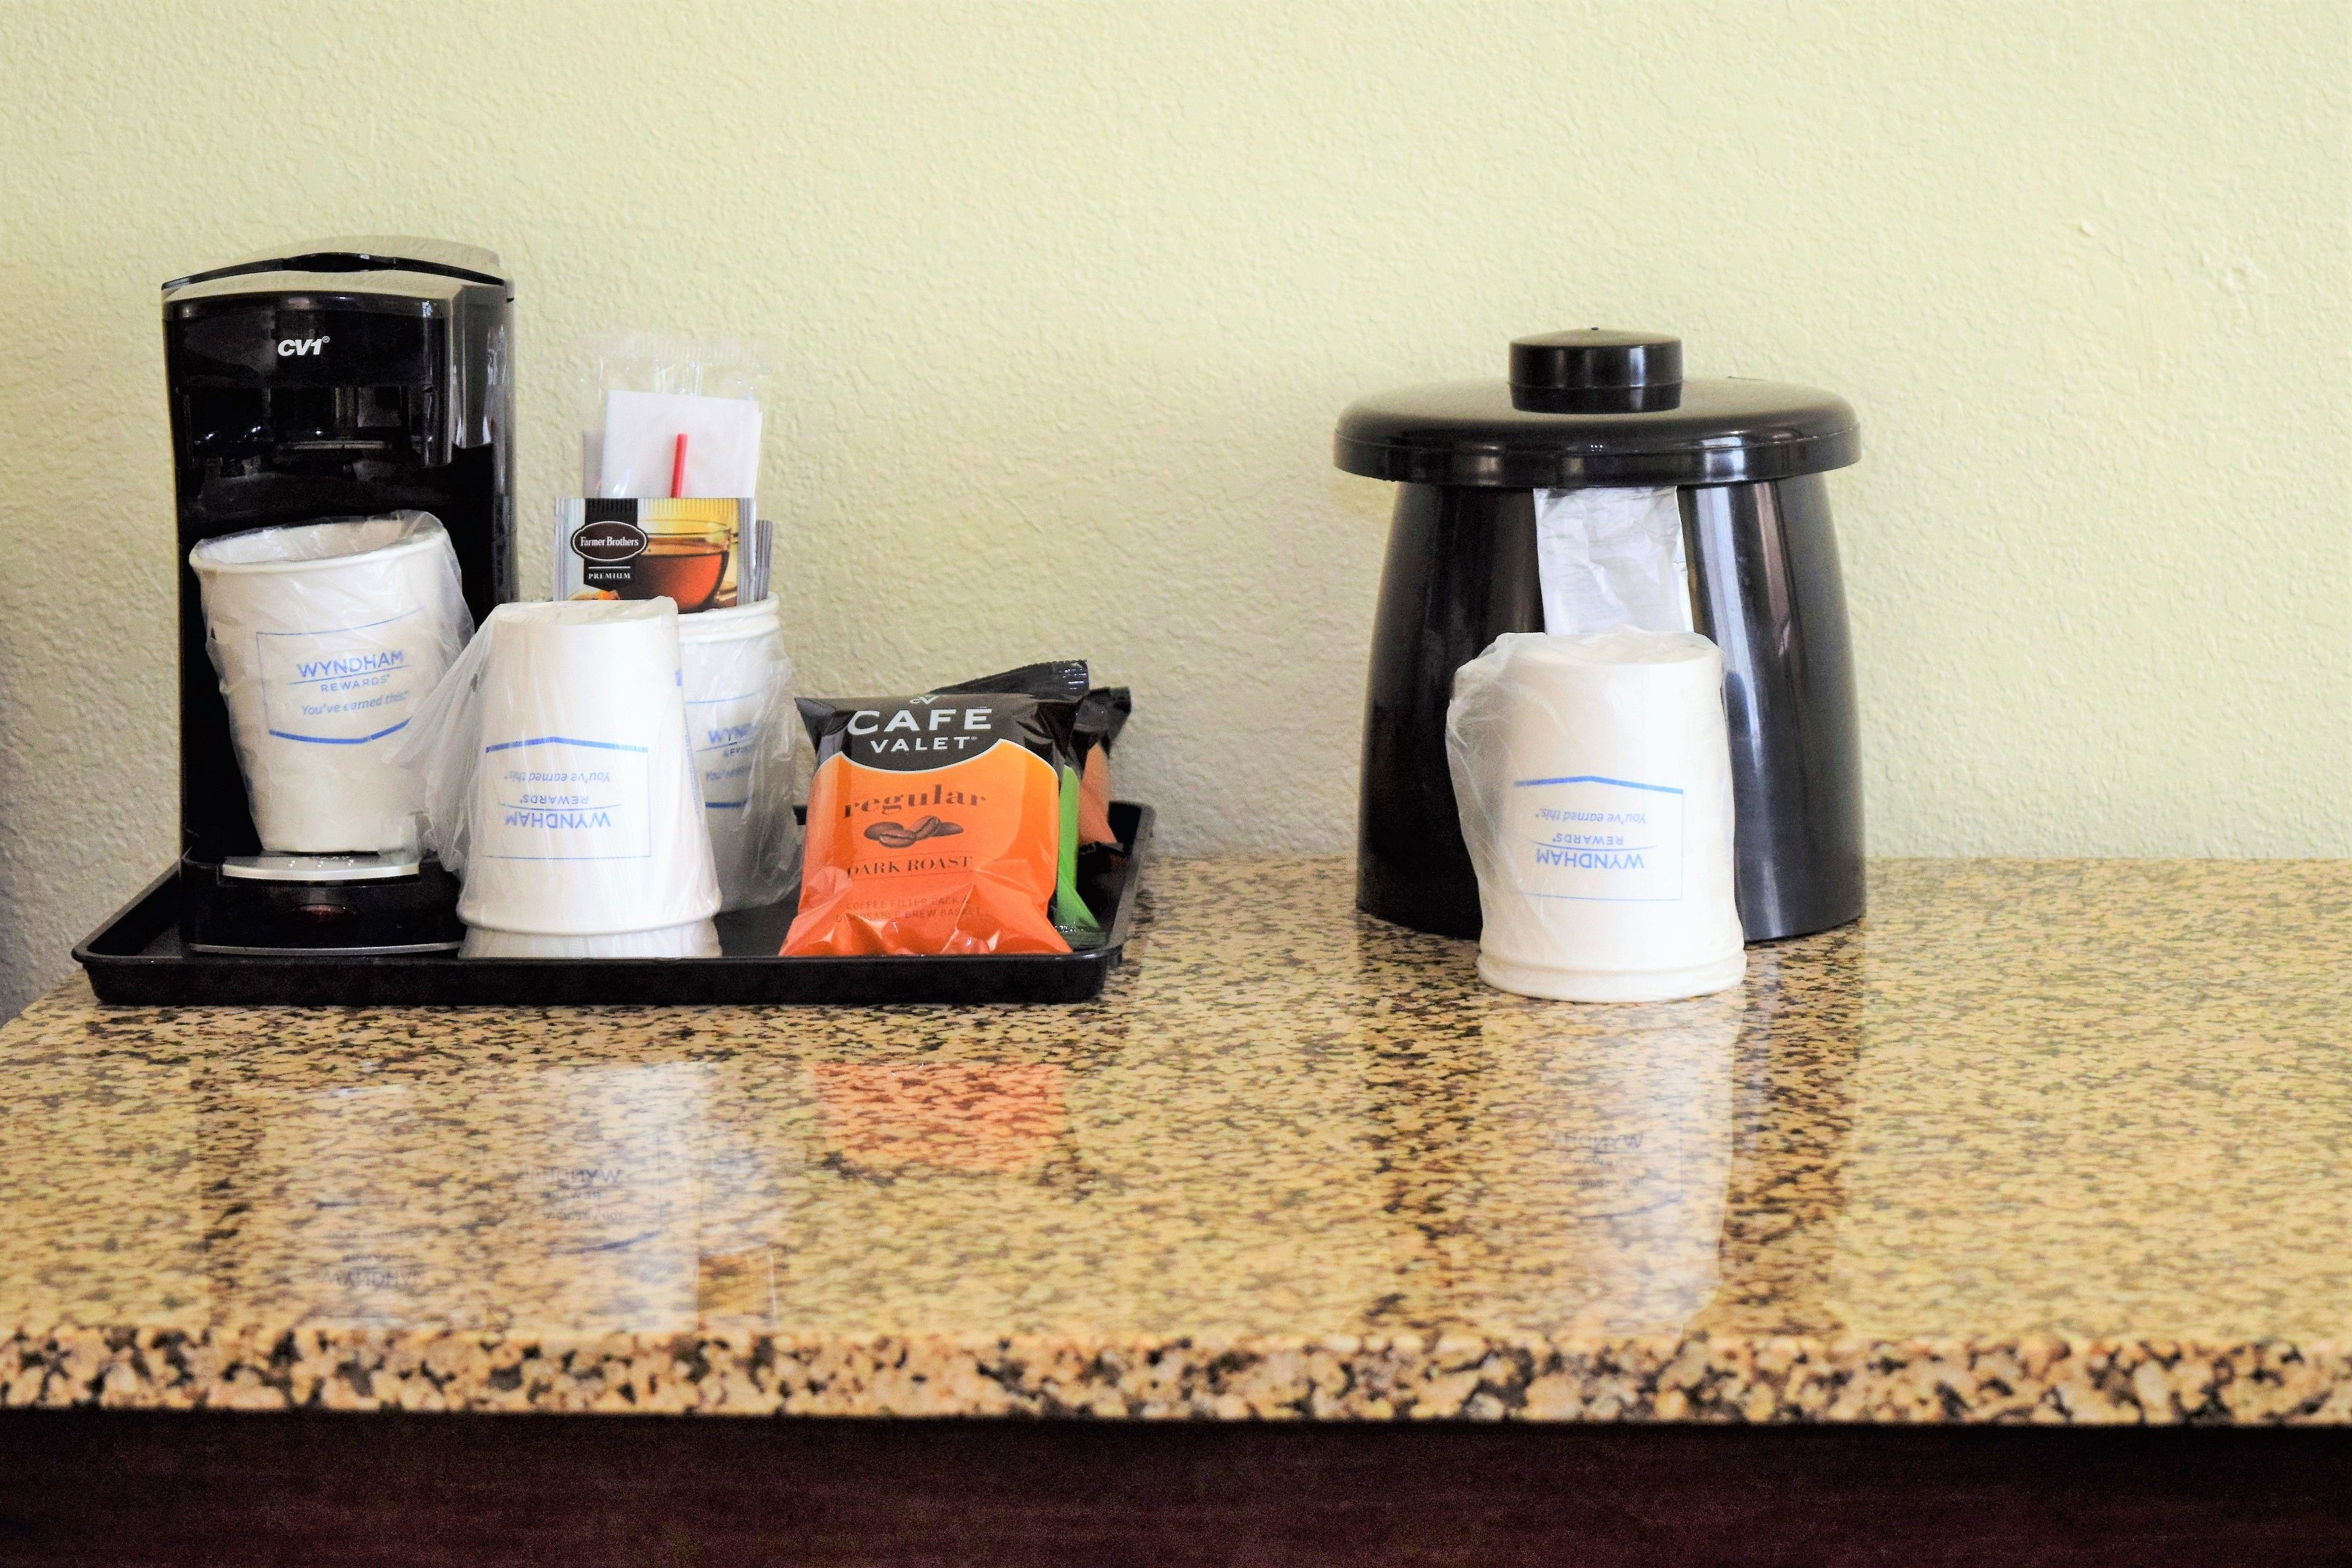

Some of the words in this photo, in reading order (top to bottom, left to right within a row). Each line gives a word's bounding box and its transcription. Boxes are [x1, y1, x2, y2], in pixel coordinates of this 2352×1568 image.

[581, 536, 606, 547] Farmer
[606, 536, 639, 547] Brothers
[296, 649, 404, 678] WYNDHAM
[302, 703, 341, 716] You've
[343, 694, 382, 712] earned
[529, 771, 568, 783] earned
[571, 771, 611, 784] You've
[843, 783, 987, 820] regular
[505, 812, 611, 829] WYNDHAM
[1563, 810, 1604, 823] earned
[1607, 812, 1646, 825] You've
[1536, 848, 1645, 870] WYNDHAM
[846, 861, 900, 878] DARK
[907, 856, 973, 872] ROAST
[846, 900, 886, 910] COFFEE
[891, 898, 927, 908] FILTER
[931, 896, 959, 906] PACK
[905, 909, 937, 919] BREW
